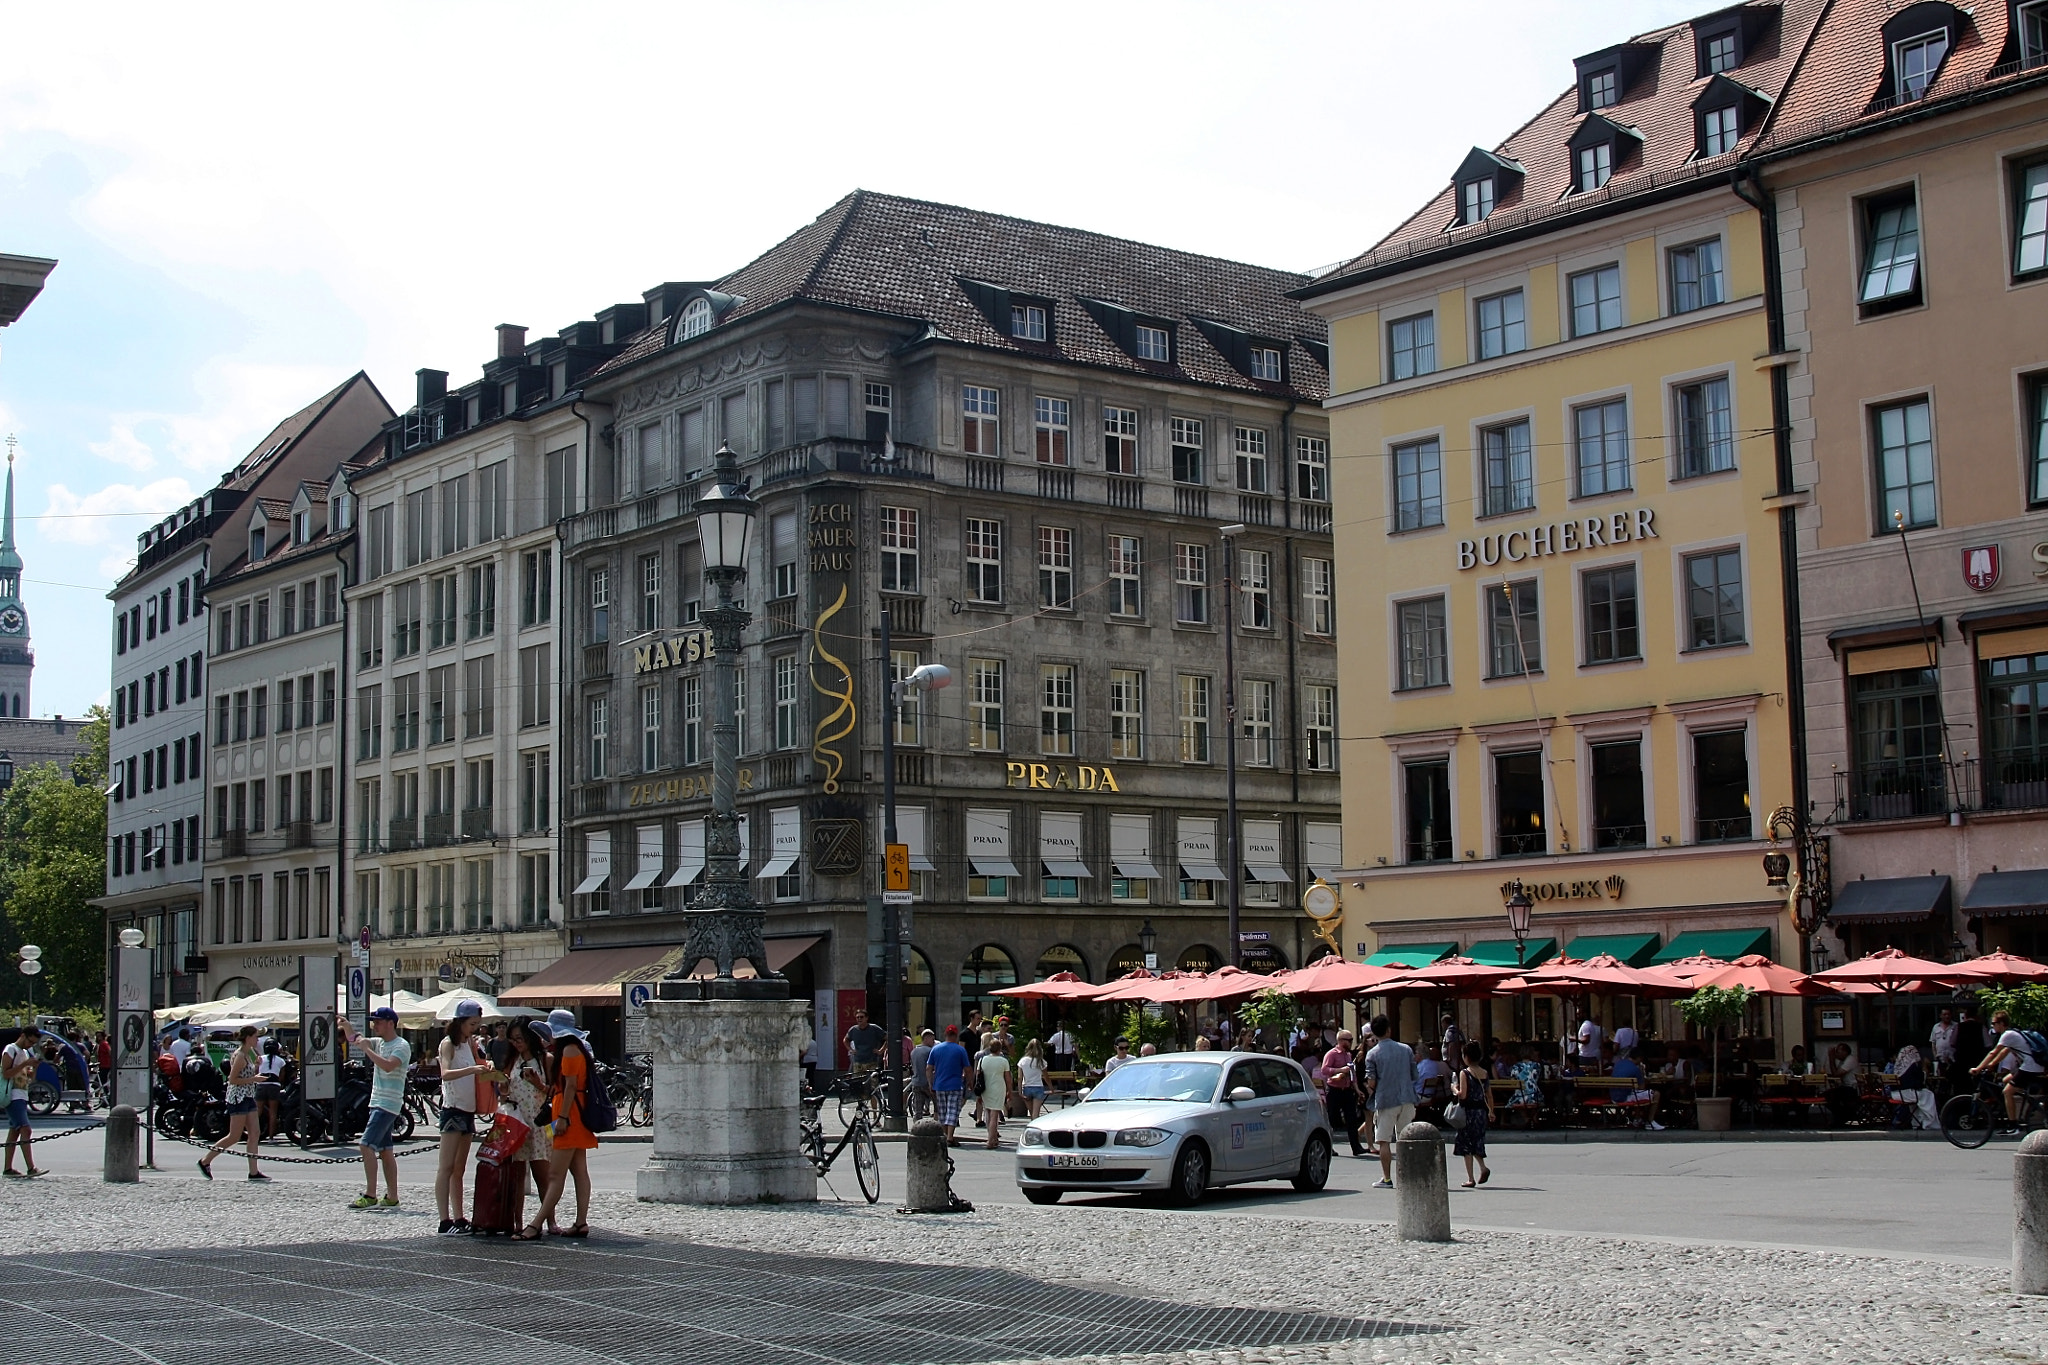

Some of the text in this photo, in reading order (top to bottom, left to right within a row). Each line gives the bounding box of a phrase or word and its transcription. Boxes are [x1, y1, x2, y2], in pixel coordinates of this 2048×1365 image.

[809, 504, 851, 524] ZECH
[808, 528, 857, 548] BAUER
[1456, 507, 1659, 571] BUCHERER
[809, 552, 853, 572] HAUS
[1006, 762, 1120, 792] PRADA
[629, 768, 753, 807] ZECHBAR
[777, 836, 796, 844] PRADA
[973, 836, 1003, 844] PRADA
[1046, 838, 1075, 846] PRADA
[1184, 842, 1210, 850] PRADA
[1523, 880, 1601, 901] ROLEX
[242, 955, 293, 969] LONGCHAMP
[403, 959, 422, 972] ZUM
[353, 1001, 362, 1009] ZONE
[124, 1055, 142, 1066] ZONE
[312, 1053, 328, 1062] ZONE
[1053, 1156, 1098, 1166] LA FL 666
